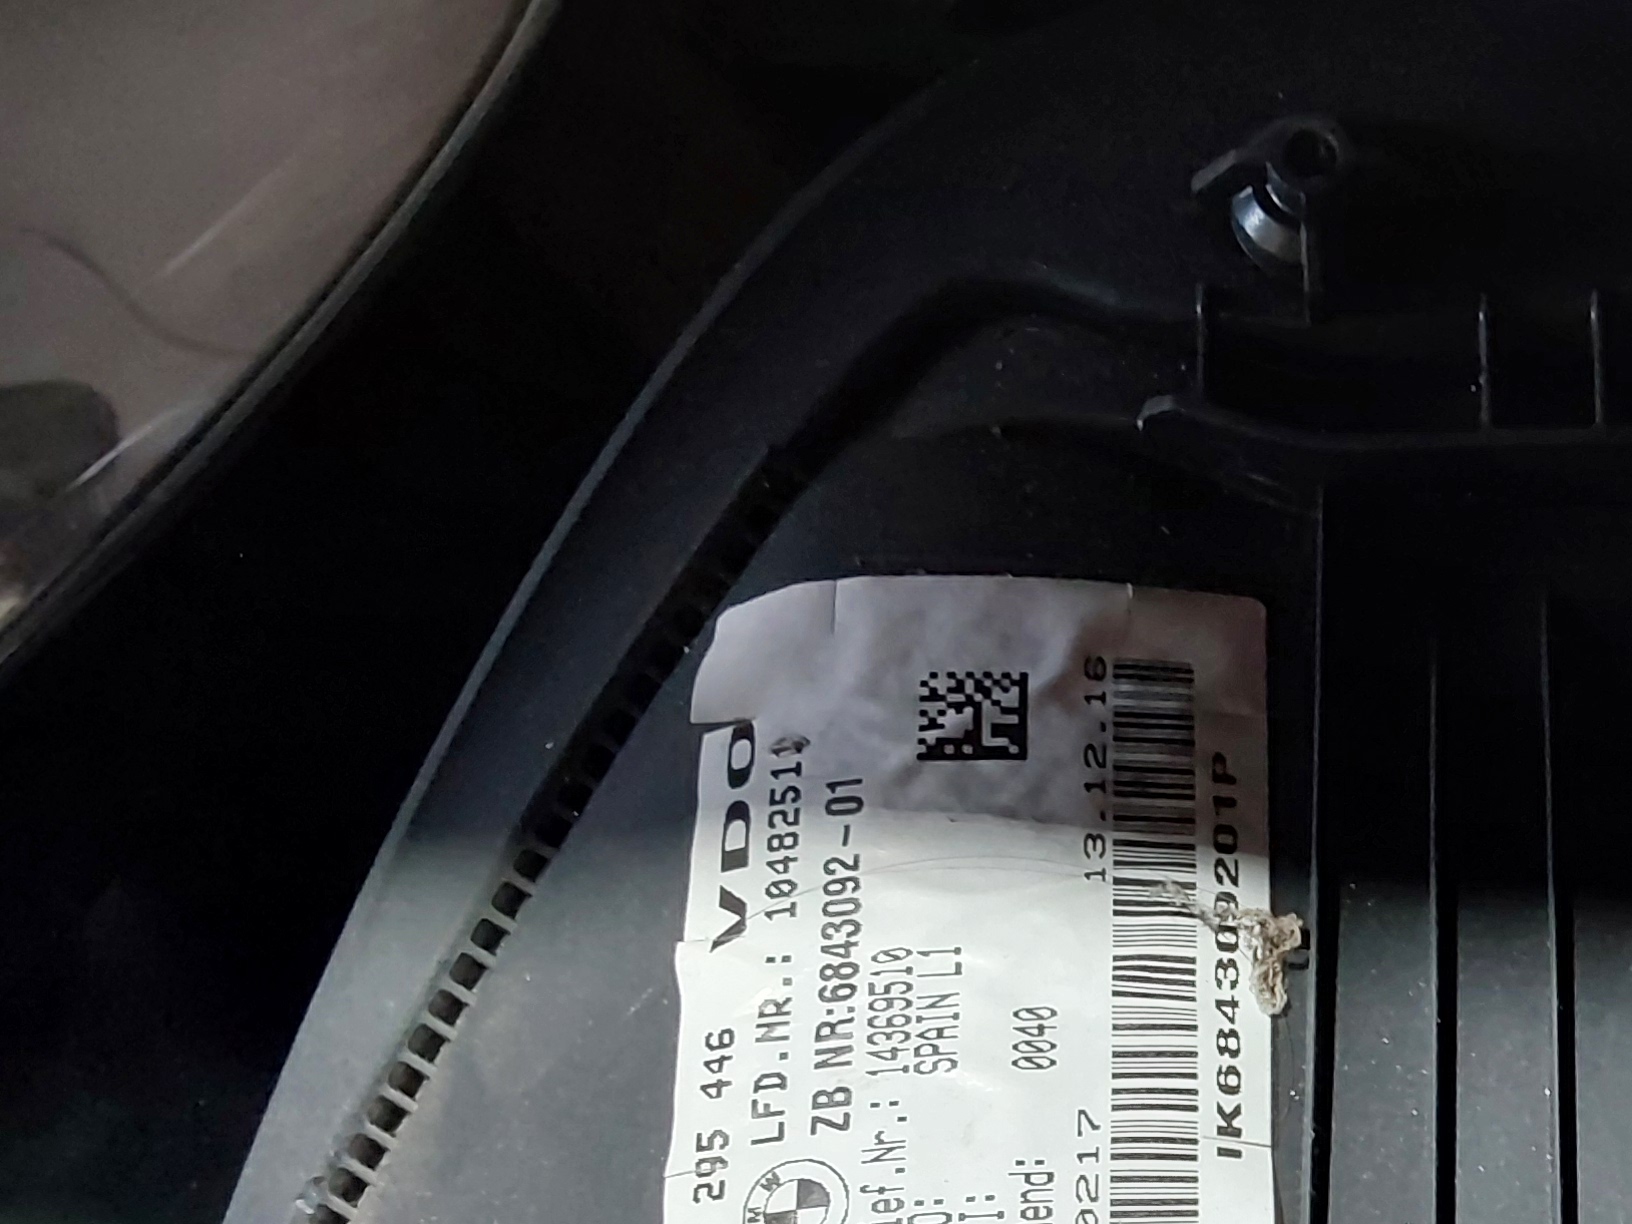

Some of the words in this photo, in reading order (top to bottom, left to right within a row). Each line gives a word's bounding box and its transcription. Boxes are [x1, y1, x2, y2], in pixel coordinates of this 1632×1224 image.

[1083, 655, 1108, 882] 13.12.16
[709, 719, 756, 952] VDO
[814, 778, 864, 1070] NR:6843092-01
[916, 947, 962, 979] L1
[868, 948, 913, 1075] 14369510
[914, 990, 959, 1074] SPAIN
[1012, 1007, 1057, 1069] 0040
[700, 1029, 735, 1099] 446
[811, 1087, 852, 1135] ZB
[693, 1130, 729, 1203] 295
